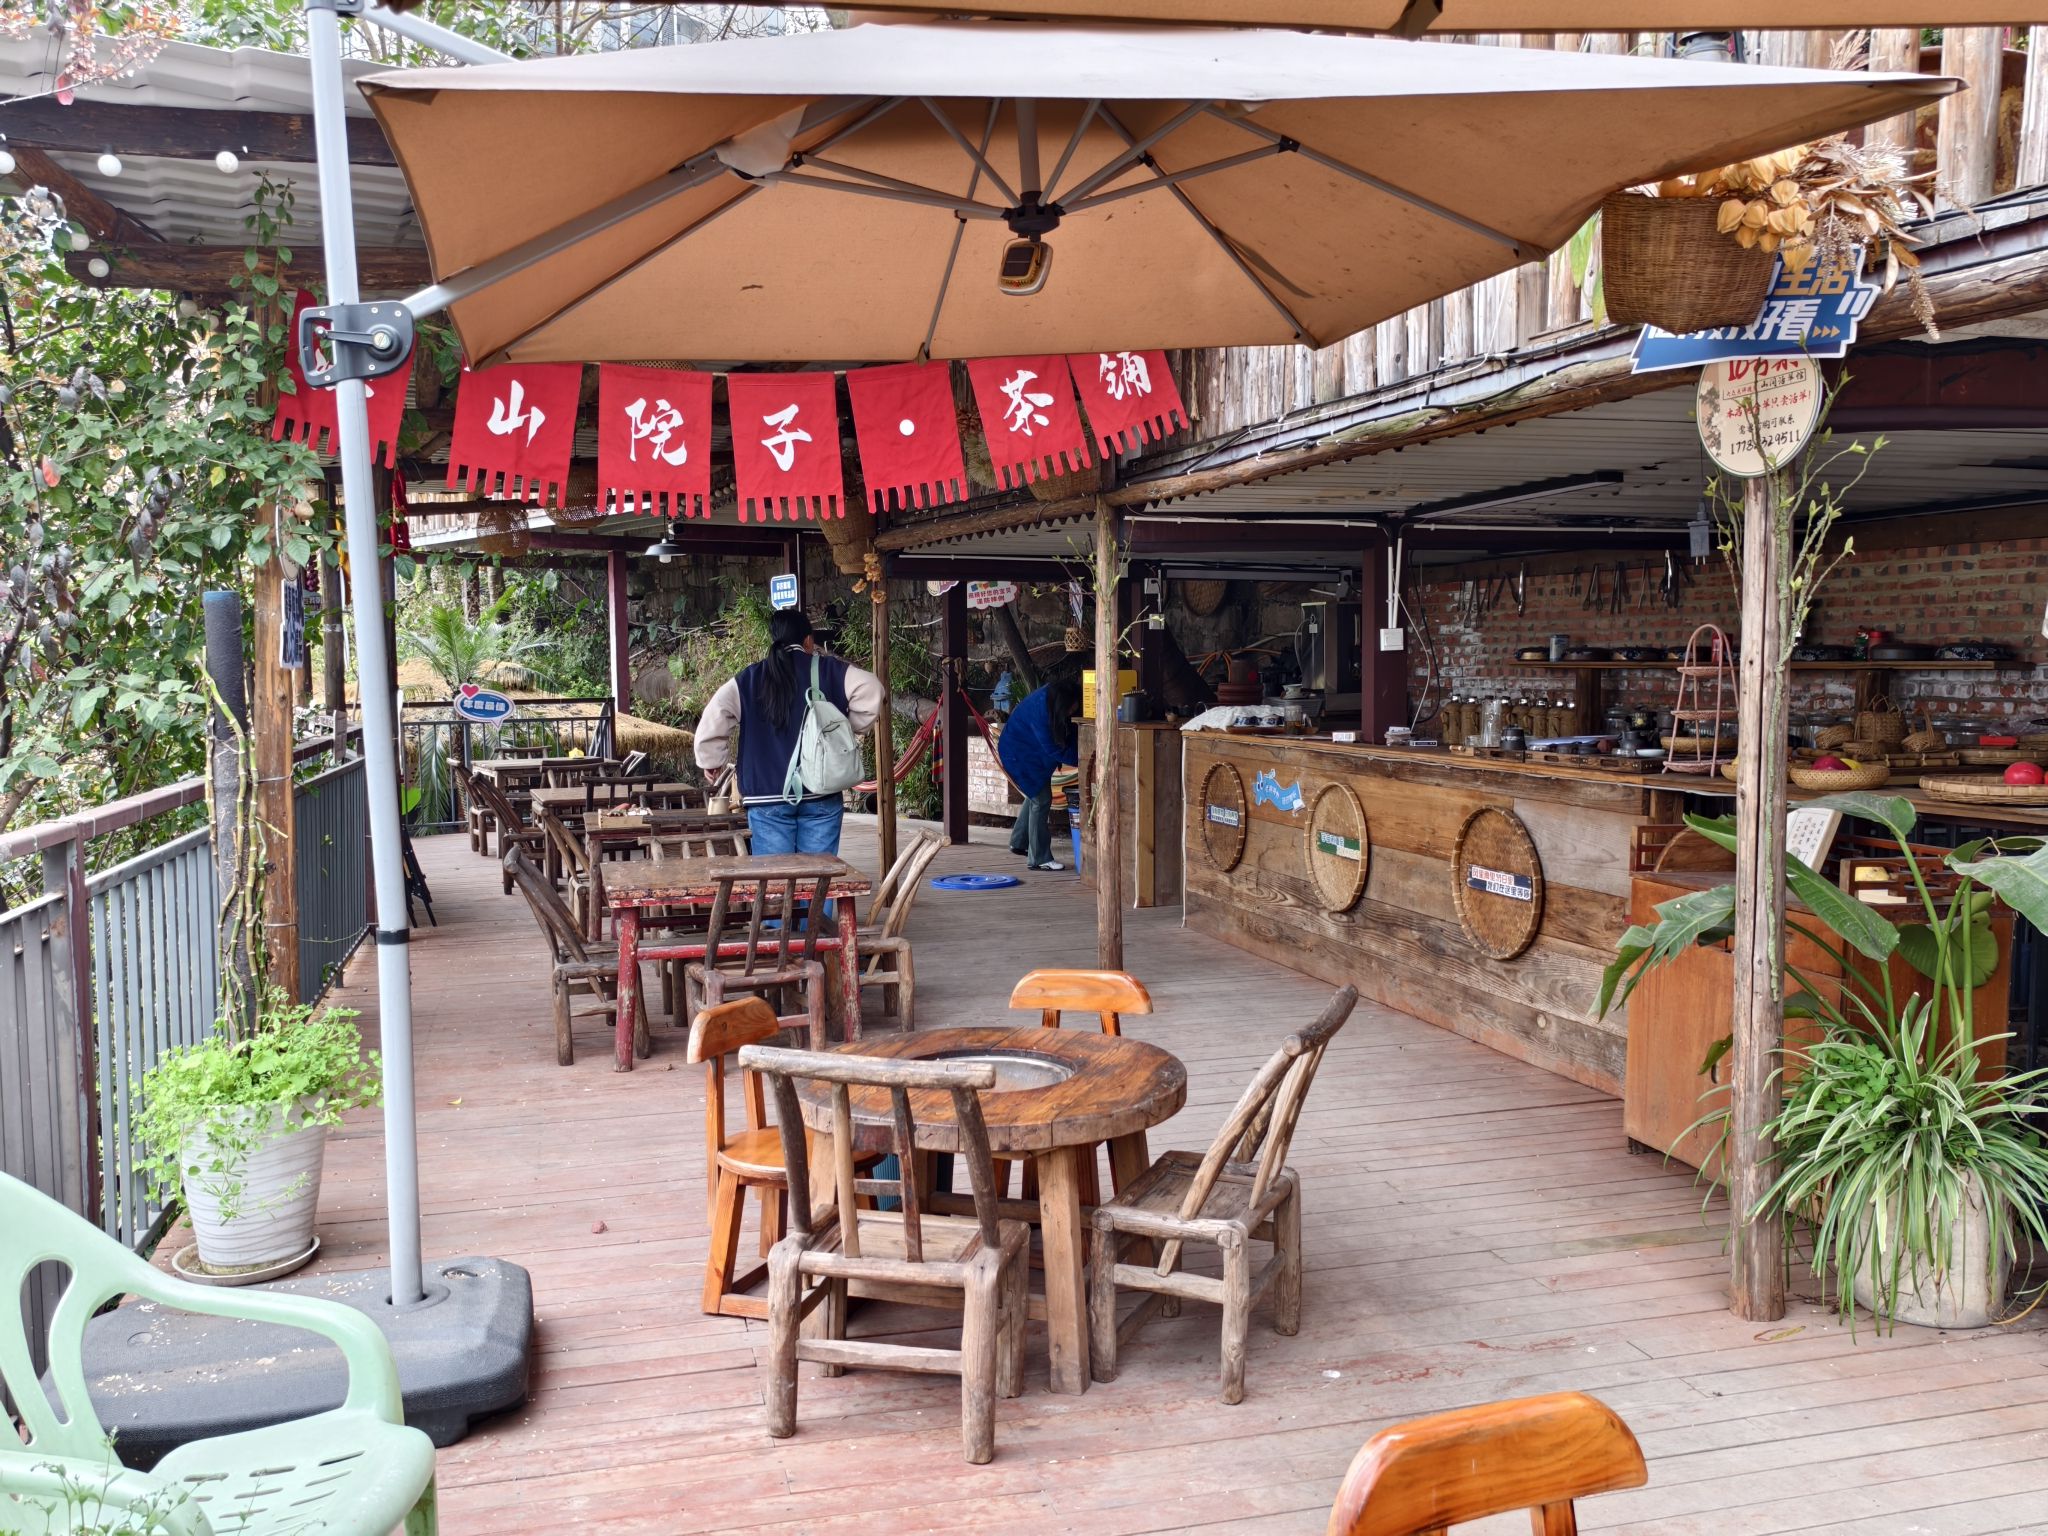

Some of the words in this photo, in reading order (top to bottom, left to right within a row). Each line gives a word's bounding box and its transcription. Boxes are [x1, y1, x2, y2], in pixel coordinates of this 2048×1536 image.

[486, 379, 546, 448] 山
[624, 397, 688, 467] 院
[761, 403, 812, 472] 子
[999, 369, 1055, 437] 茶
